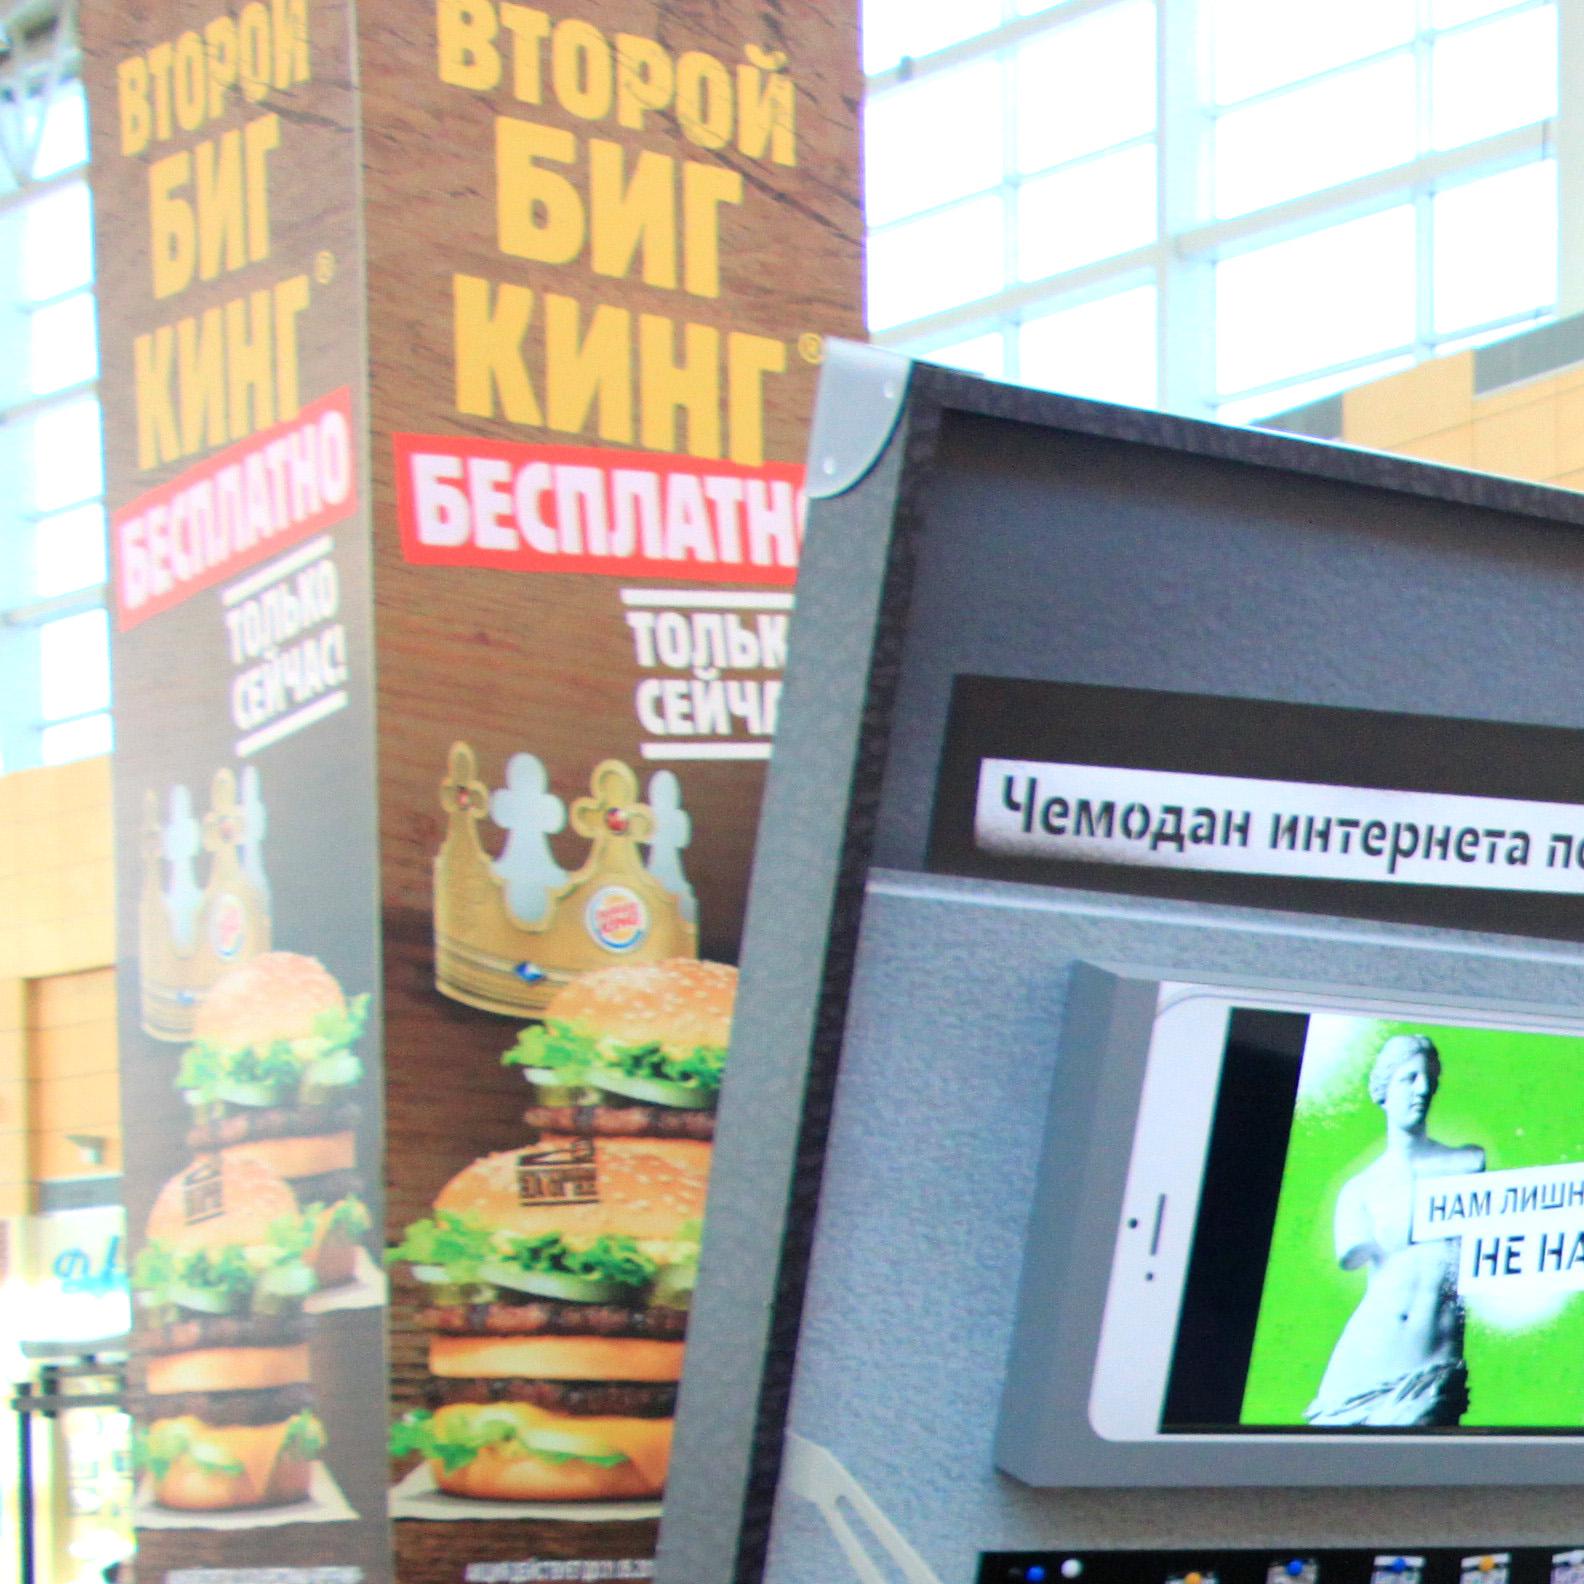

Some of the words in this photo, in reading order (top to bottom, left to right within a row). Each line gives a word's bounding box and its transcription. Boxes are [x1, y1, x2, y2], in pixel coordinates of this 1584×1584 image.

[436, 0, 797, 167] ВТОРОЙ
[149, 112, 280, 300] БИГ
[495, 115, 744, 299] БИГ
[134, 273, 311, 470] КИНГ
[452, 272, 788, 467] КИНГ
[119, 410, 351, 609] БЕСПЛАТНО
[409, 451, 808, 567] БЕСПЛАТН
[224, 559, 340, 665] ТОЛЬКО
[625, 611, 789, 668] ТОЛЬК
[230, 623, 348, 730] СЕЙЧАС!
[1001, 774, 1252, 853] Чемодан
[1269, 811, 1531, 875] интернета
[1427, 1190, 1492, 1223] НАМ
[1472, 1235, 1526, 1278] НЕ
